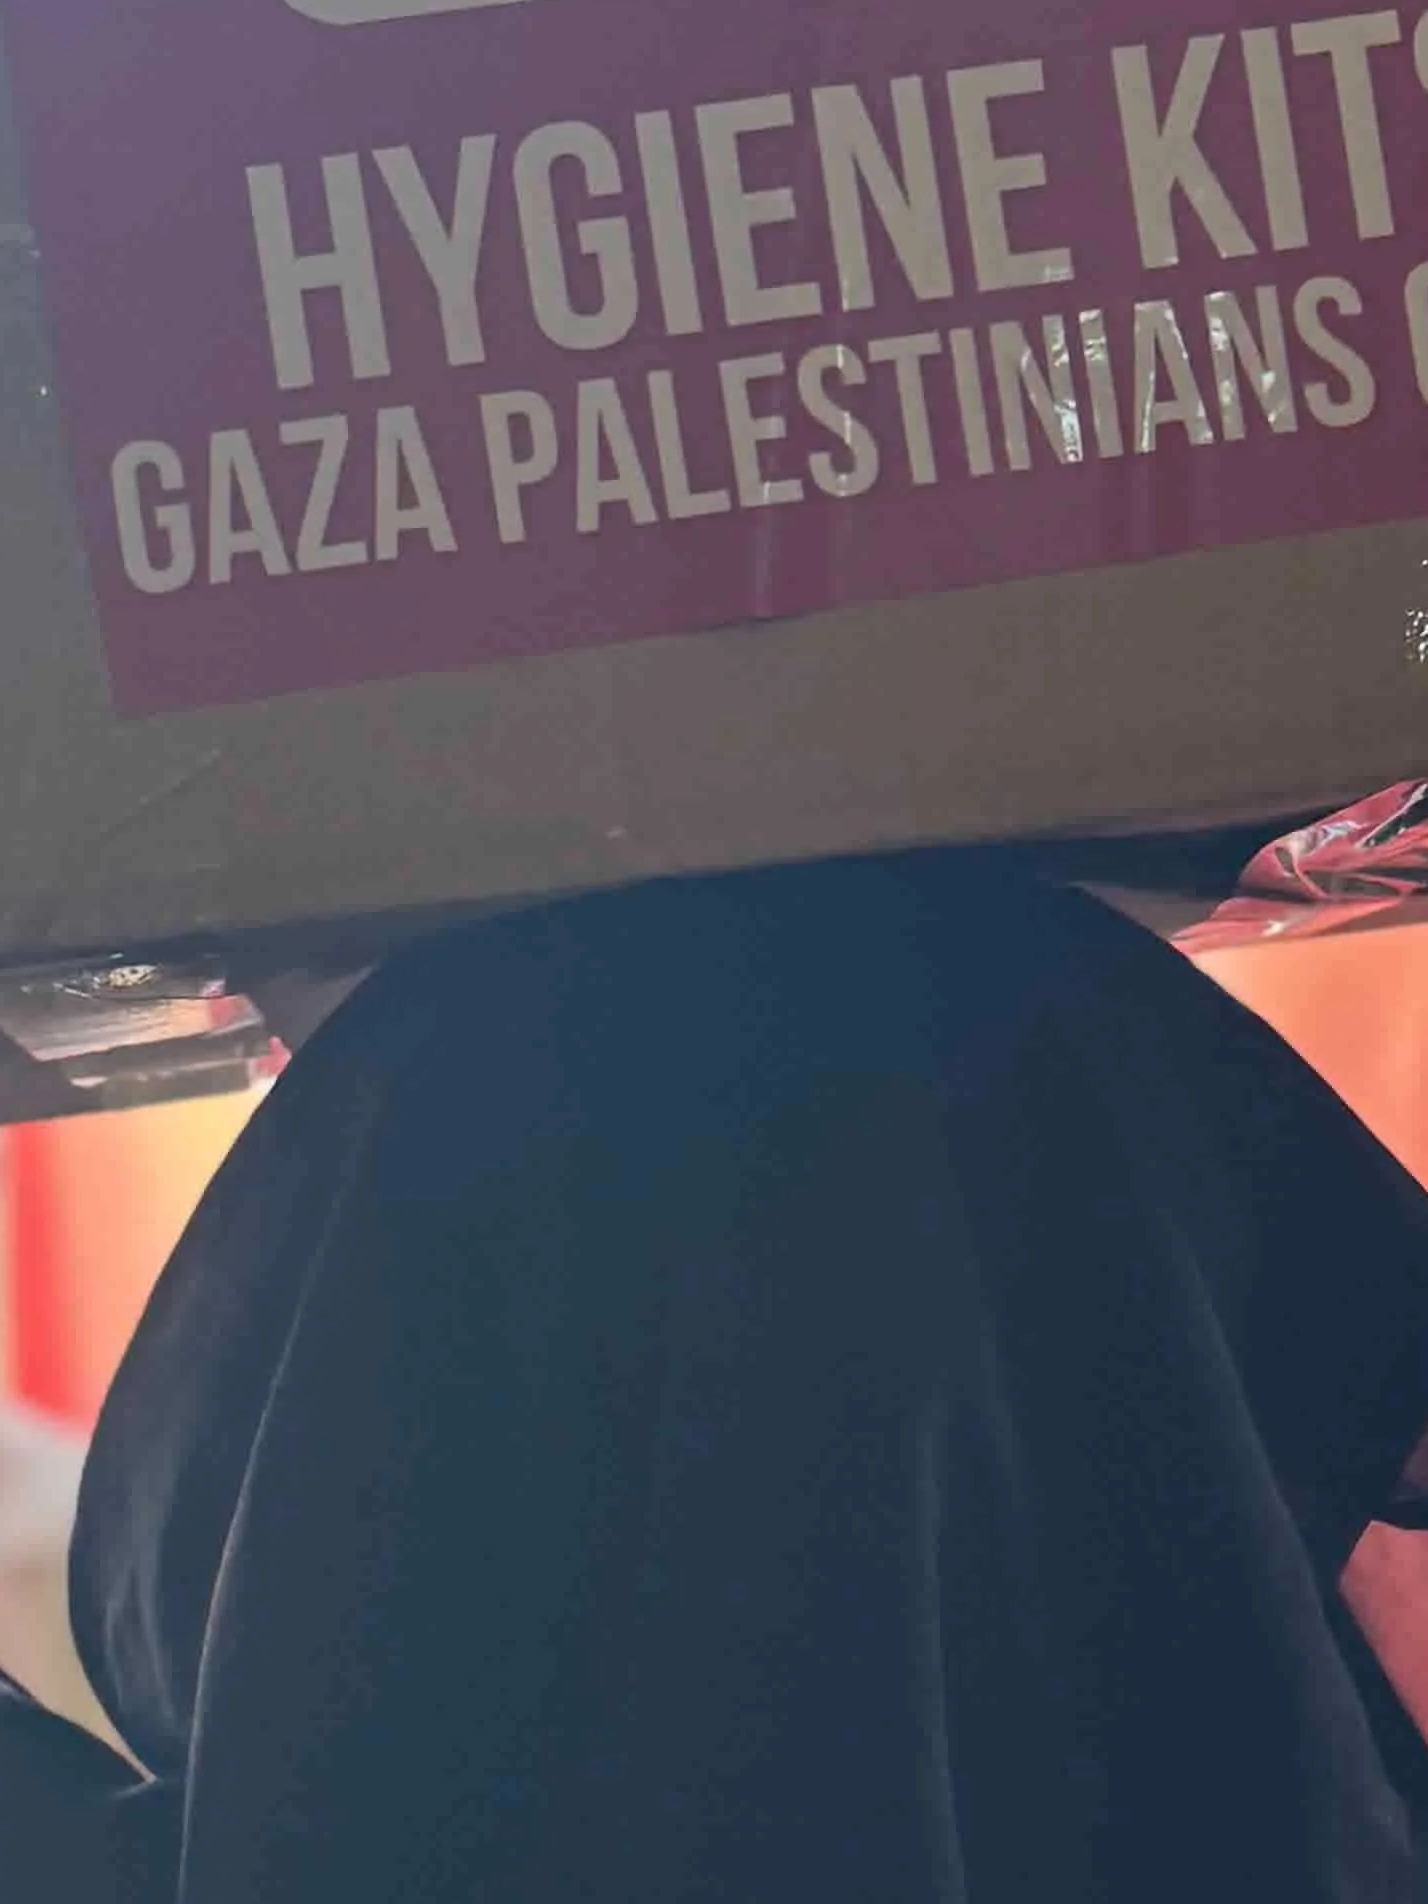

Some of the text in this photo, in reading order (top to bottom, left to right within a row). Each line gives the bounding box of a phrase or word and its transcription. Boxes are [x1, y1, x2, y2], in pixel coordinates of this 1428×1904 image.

[246, 58, 1071, 388] HYGIENE
[110, 406, 456, 593] GAZA
[482, 275, 1376, 542] PALESTINIANS
